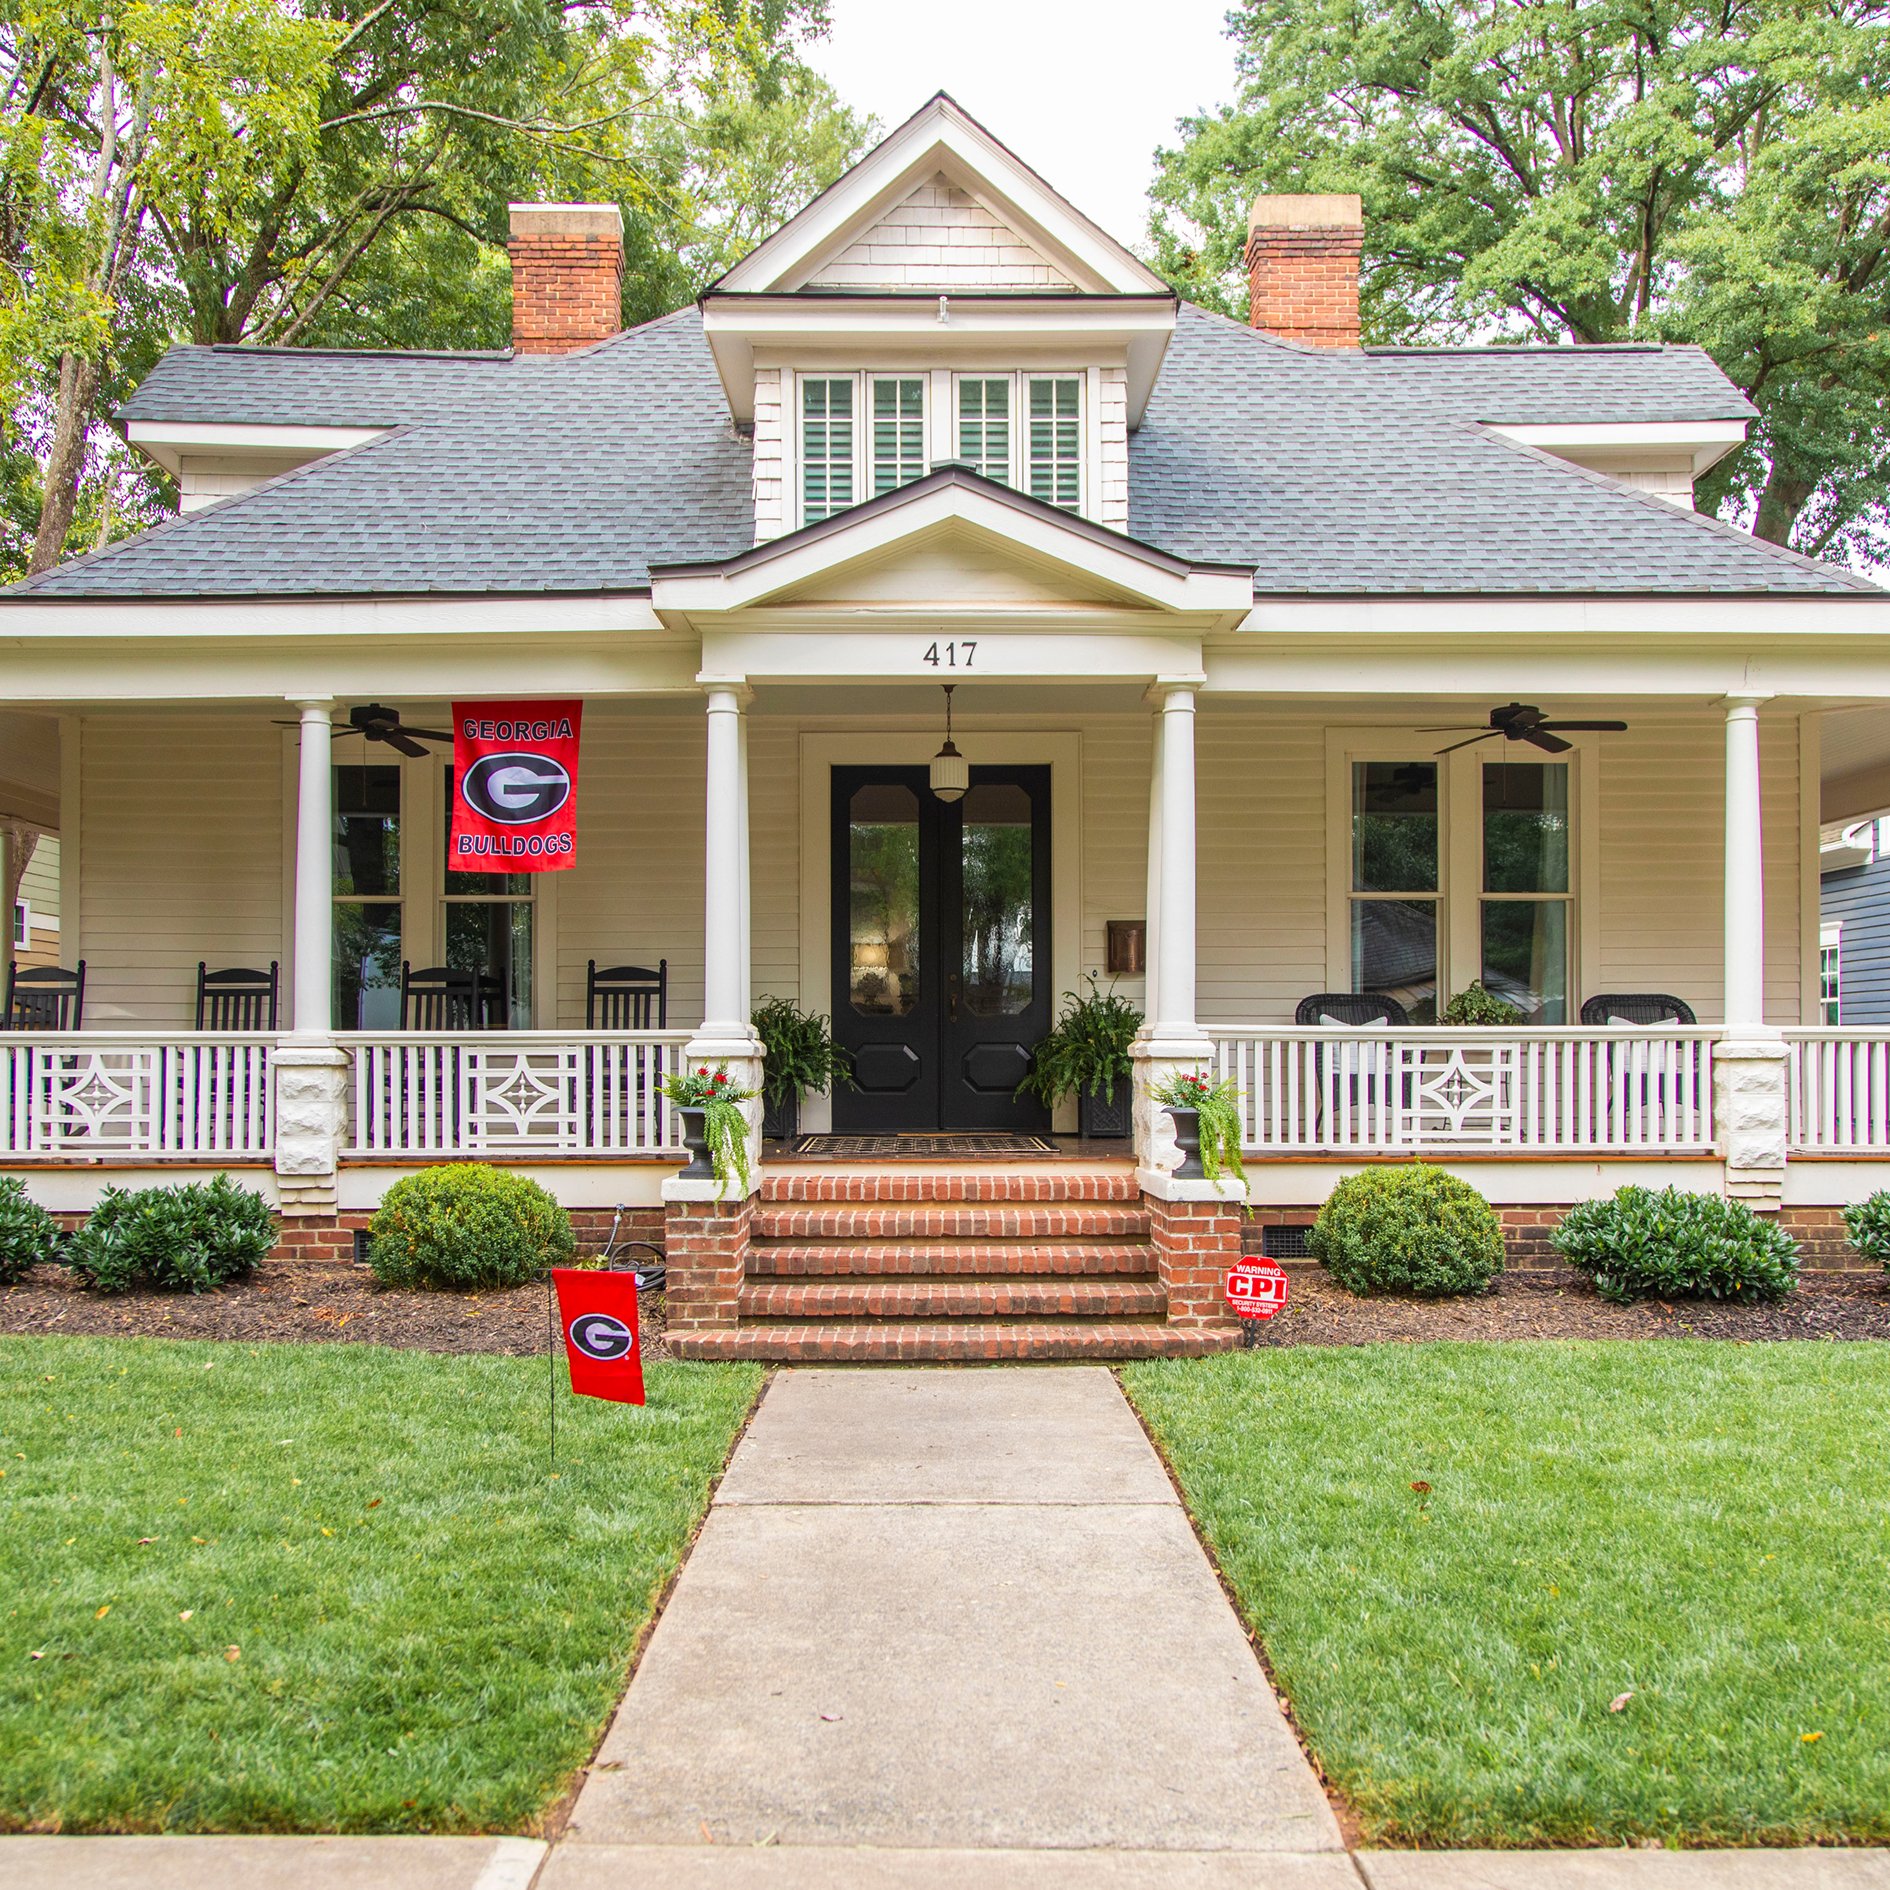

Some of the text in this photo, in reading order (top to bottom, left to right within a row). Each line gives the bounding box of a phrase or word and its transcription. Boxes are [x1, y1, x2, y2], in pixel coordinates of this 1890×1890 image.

[923, 641, 978, 666] 417
[463, 718, 574, 741] GEORGIA
[461, 751, 571, 825] G
[457, 833, 573, 857] BULLDOGS
[1236, 1265, 1281, 1276] WARNING
[1228, 1275, 1286, 1300] CPI
[1232, 1299, 1279, 1309] SECURITY SYSTEMS
[569, 1312, 633, 1361] G
